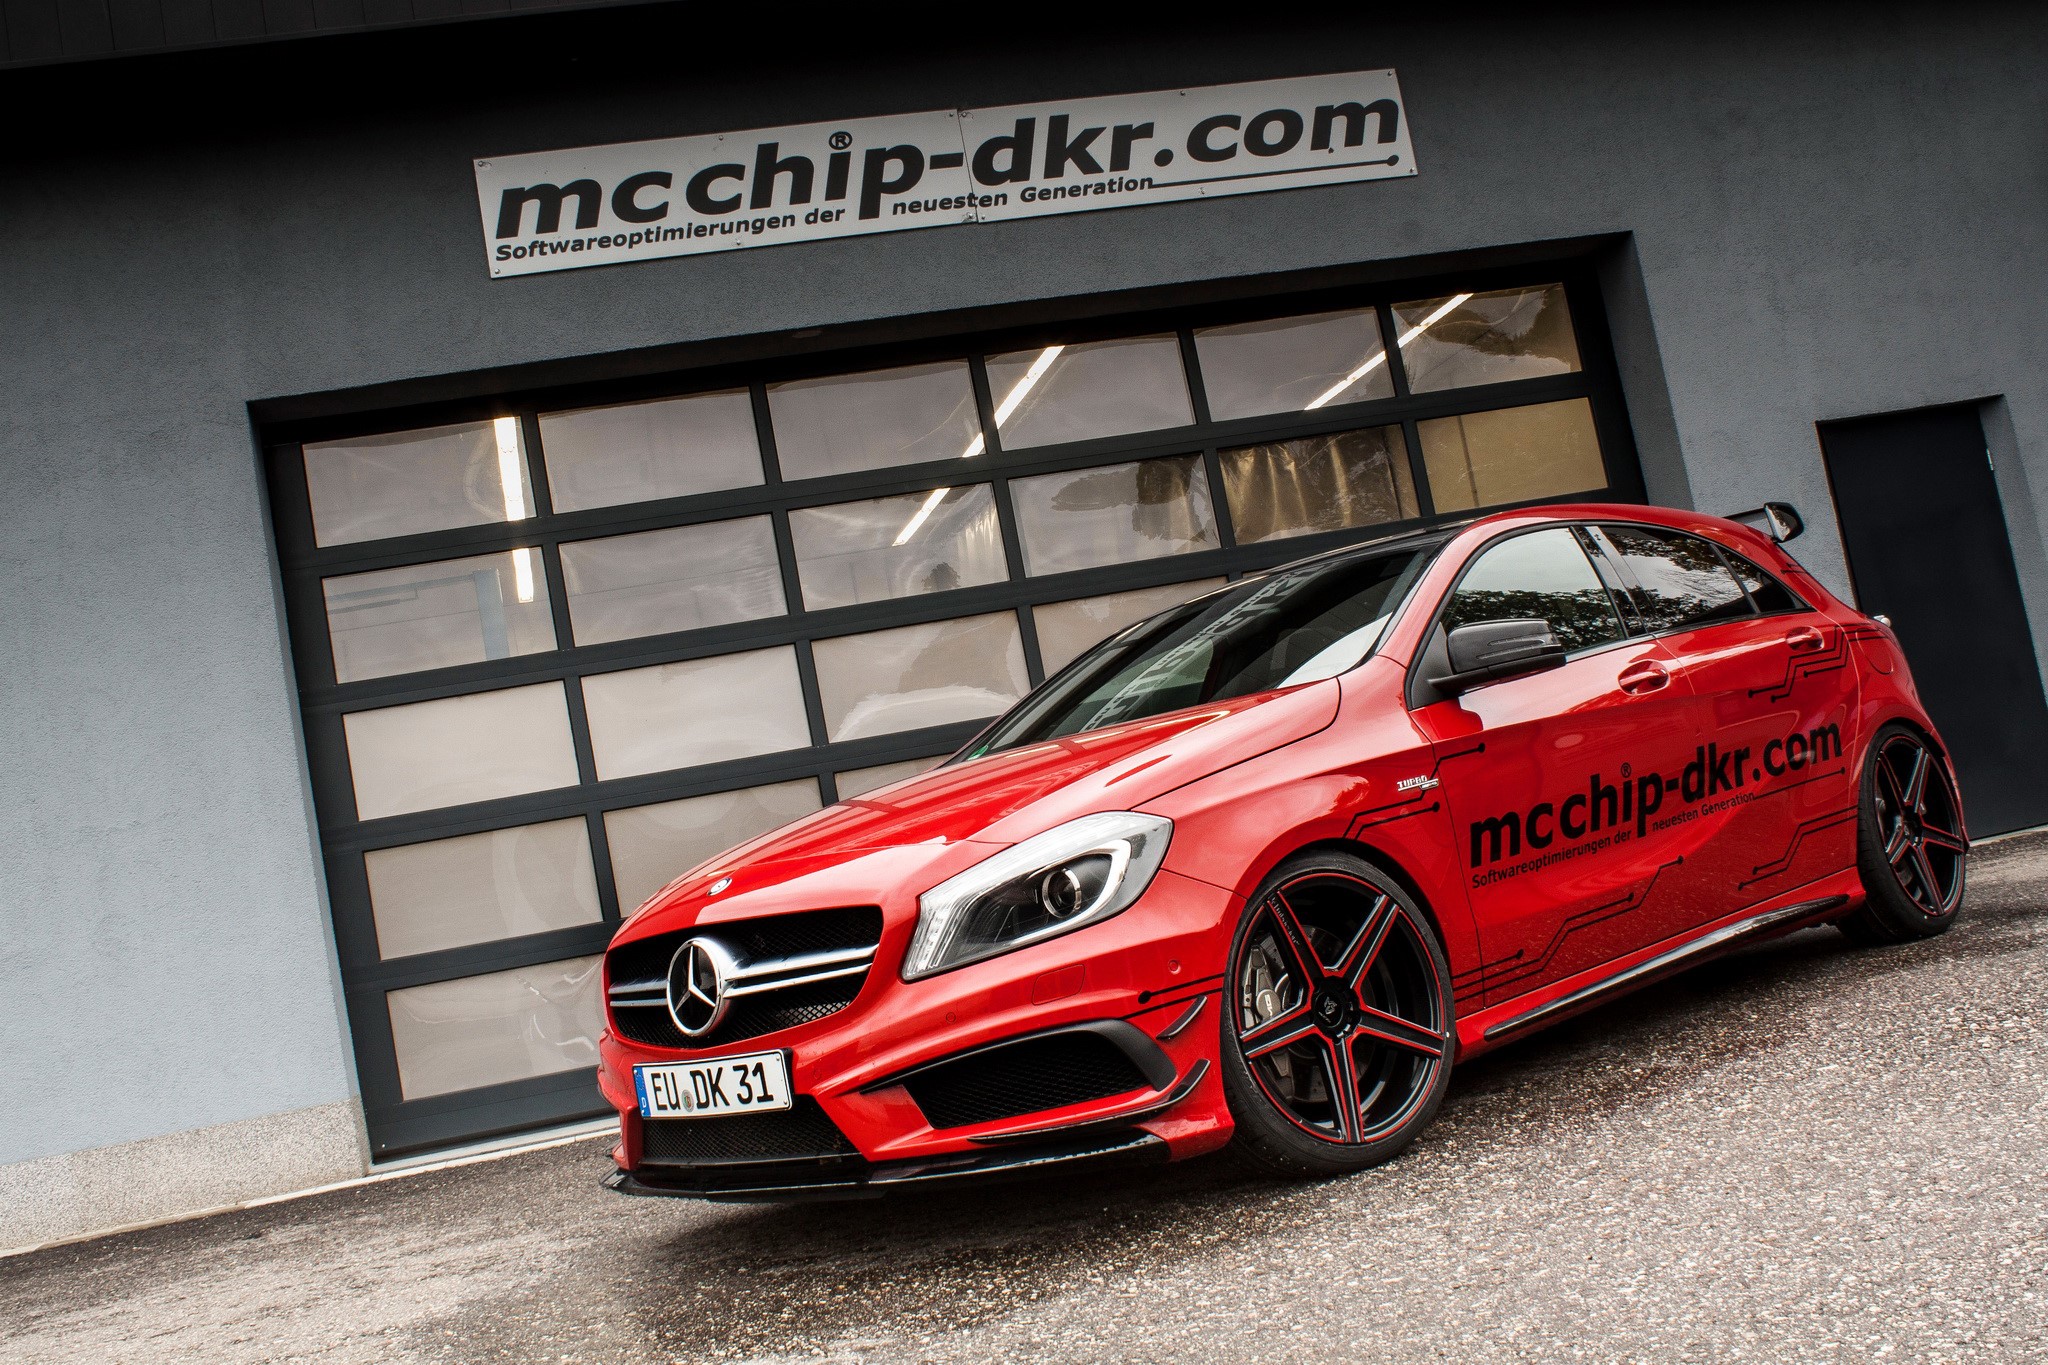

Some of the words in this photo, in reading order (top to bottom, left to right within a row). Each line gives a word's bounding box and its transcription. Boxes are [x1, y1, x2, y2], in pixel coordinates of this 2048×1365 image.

[495, 98, 1399, 239] mcchip-dkr.com
[495, 211, 796, 262] Softwareoptimierungen
[804, 205, 846, 226] der
[892, 191, 1008, 216] neuesten
[1019, 174, 1154, 204] Generation
[1469, 721, 1843, 869] mcchip-dkr.com
[1471, 833, 1611, 889] Softwareoptimierungen
[1613, 829, 1632, 845] der
[1651, 808, 1699, 832] neuesten
[1700, 791, 1756, 816] Generation
[650, 1072, 681, 1111] EU
[690, 1066, 730, 1109] DK
[732, 1062, 774, 1105] 31
